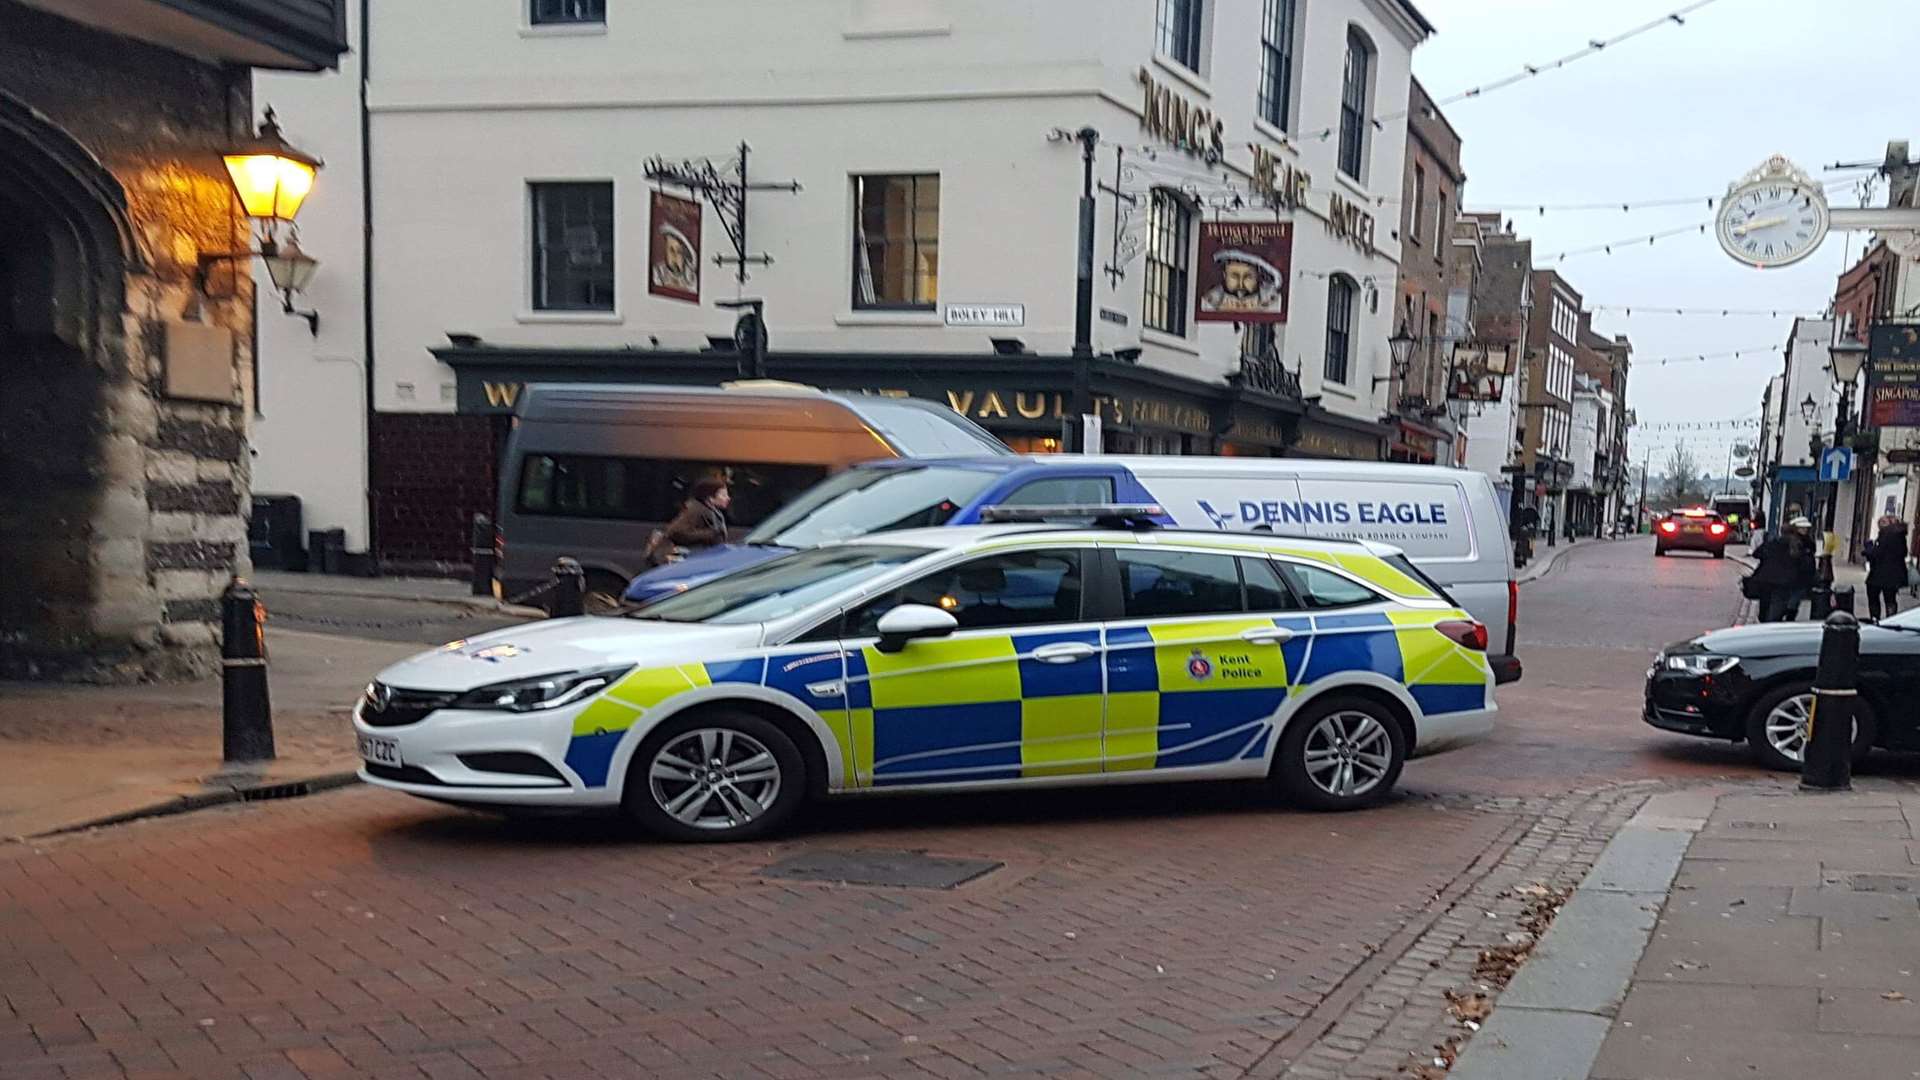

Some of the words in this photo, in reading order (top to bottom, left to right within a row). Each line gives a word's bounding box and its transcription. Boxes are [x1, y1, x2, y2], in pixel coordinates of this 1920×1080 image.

[1239, 501, 1350, 524] DENNIS
[1359, 502, 1448, 525] EAGLE
[1219, 654, 1251, 666] Kent
[1222, 666, 1263, 679] Police
